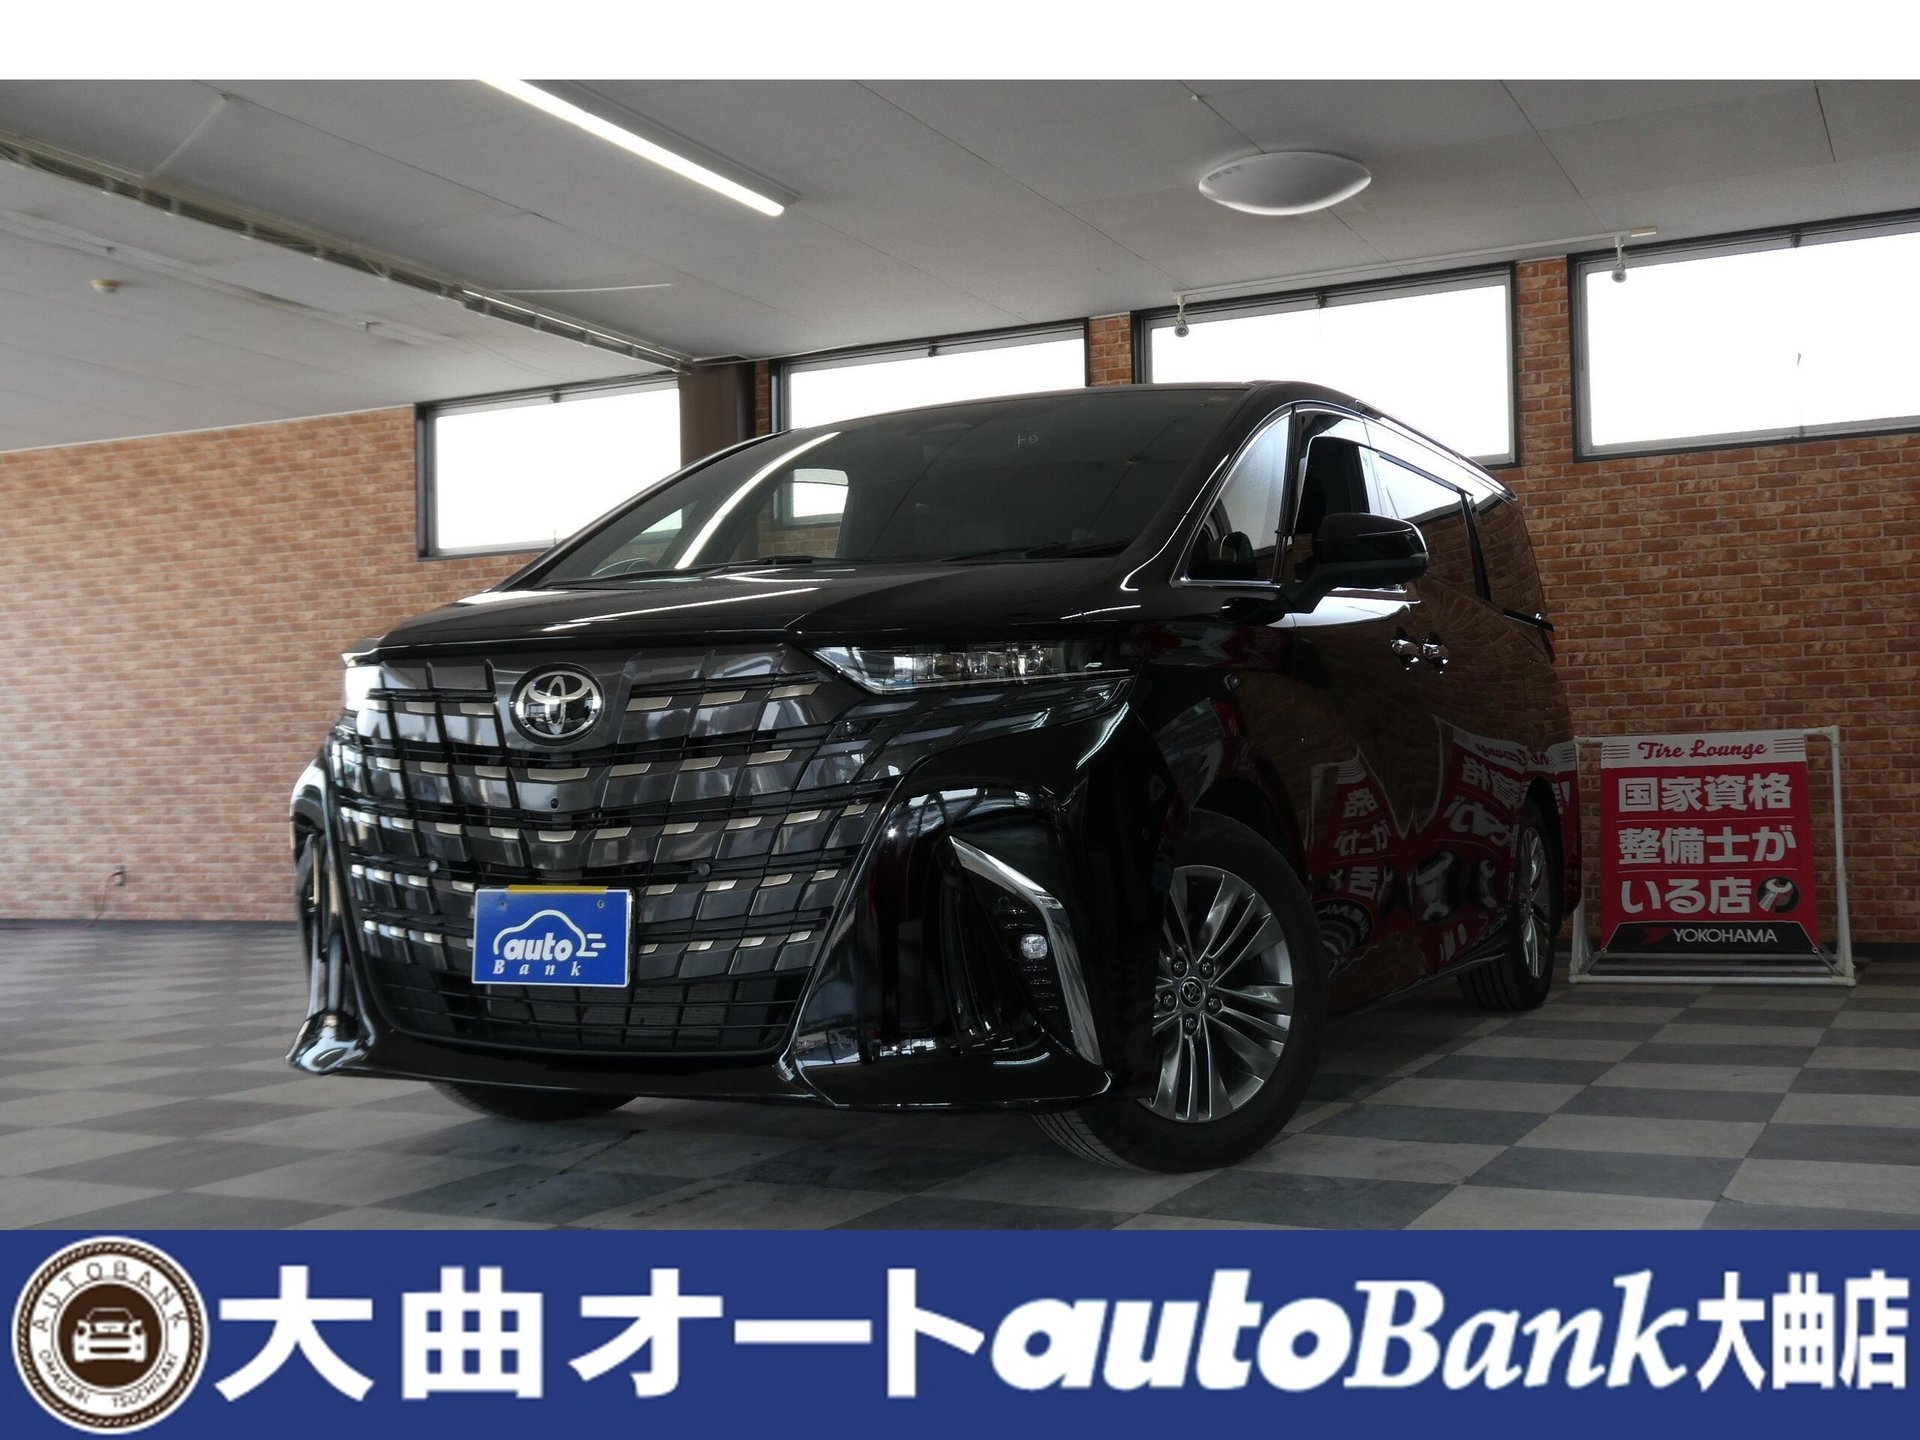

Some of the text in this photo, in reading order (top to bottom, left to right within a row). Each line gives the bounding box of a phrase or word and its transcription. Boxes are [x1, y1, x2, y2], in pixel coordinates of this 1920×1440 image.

[1637, 738, 1767, 760] Tire Lounge
[1618, 773, 1792, 812] 国家資格
[1618, 825, 1797, 865] 整備士が
[1621, 876, 1752, 914] いる店
[503, 932, 573, 961] auto
[1673, 928, 1778, 943] YOKOHAMA
